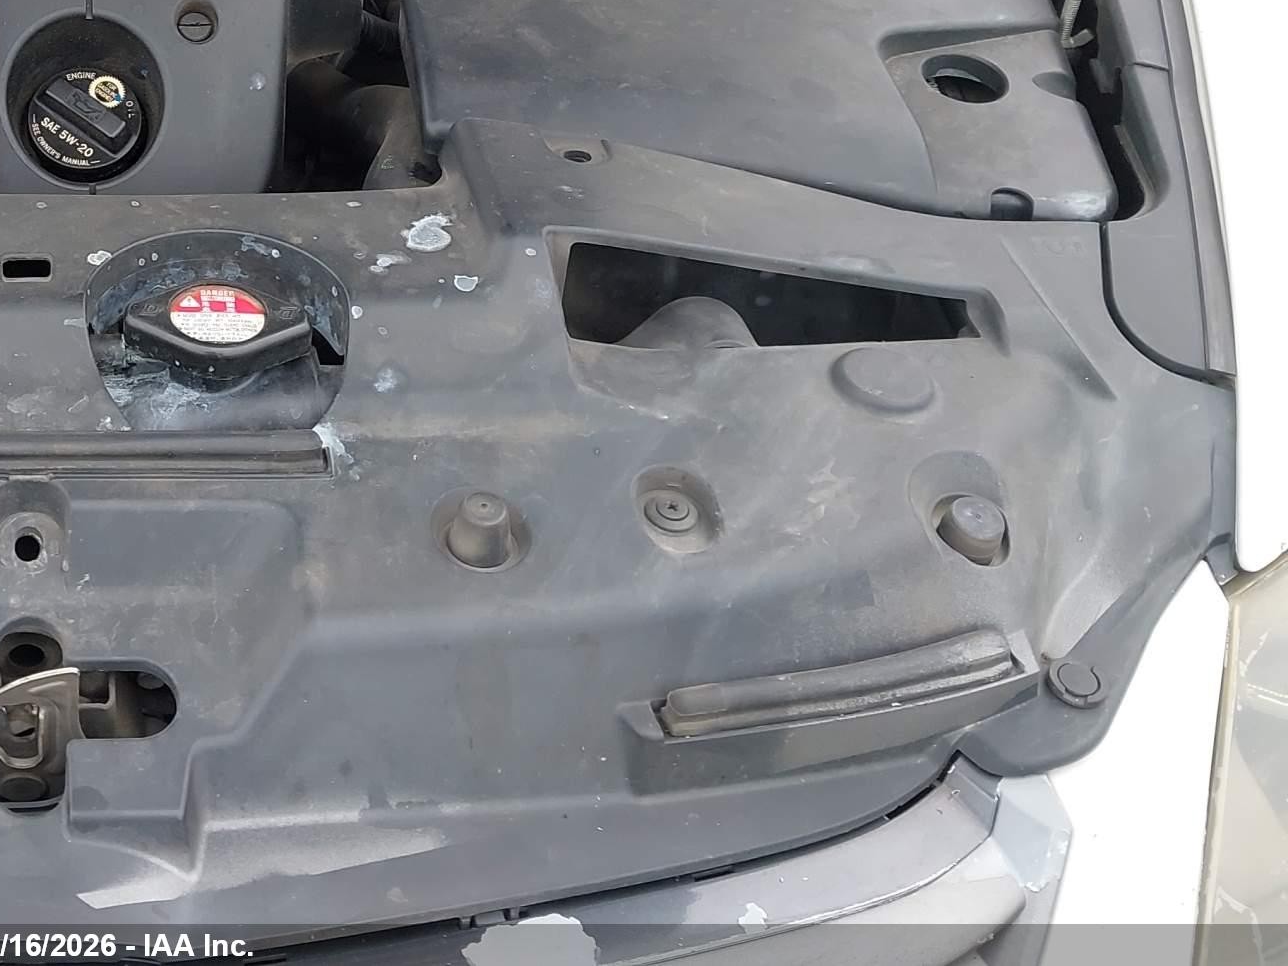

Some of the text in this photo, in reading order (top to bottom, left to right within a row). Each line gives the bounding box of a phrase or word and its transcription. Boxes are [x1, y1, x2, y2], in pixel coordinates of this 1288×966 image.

[65, 72, 135, 119] ENGINE OIL
[31, 123, 91, 166] SEE OWNER'S MANUAL
[40, 117, 94, 157] SAE 5W-20
